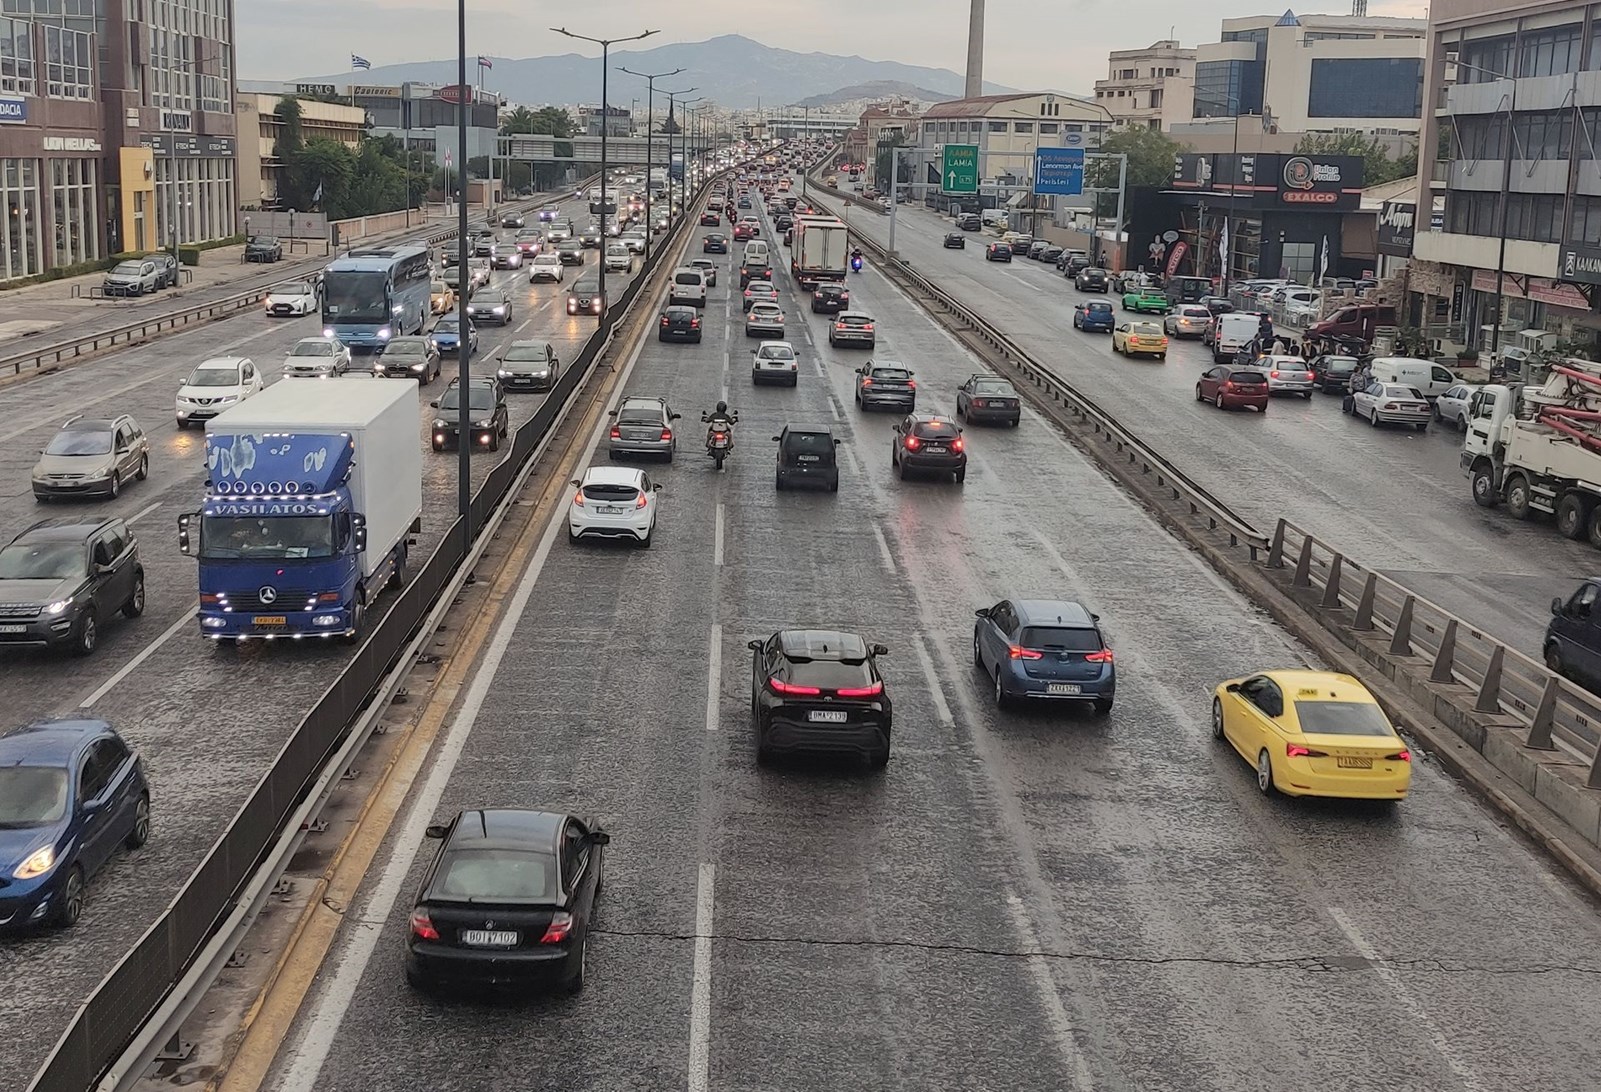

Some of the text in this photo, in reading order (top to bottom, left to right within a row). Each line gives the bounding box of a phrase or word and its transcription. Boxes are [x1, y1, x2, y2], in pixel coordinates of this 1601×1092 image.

[0, 103, 21, 116] DACIA
[948, 159, 973, 167] LAMIA
[1314, 165, 1339, 174] Union
[1313, 173, 1341, 181] Profile
[1287, 193, 1335, 202] EXALCO
[215, 504, 317, 515] VASILATOS
